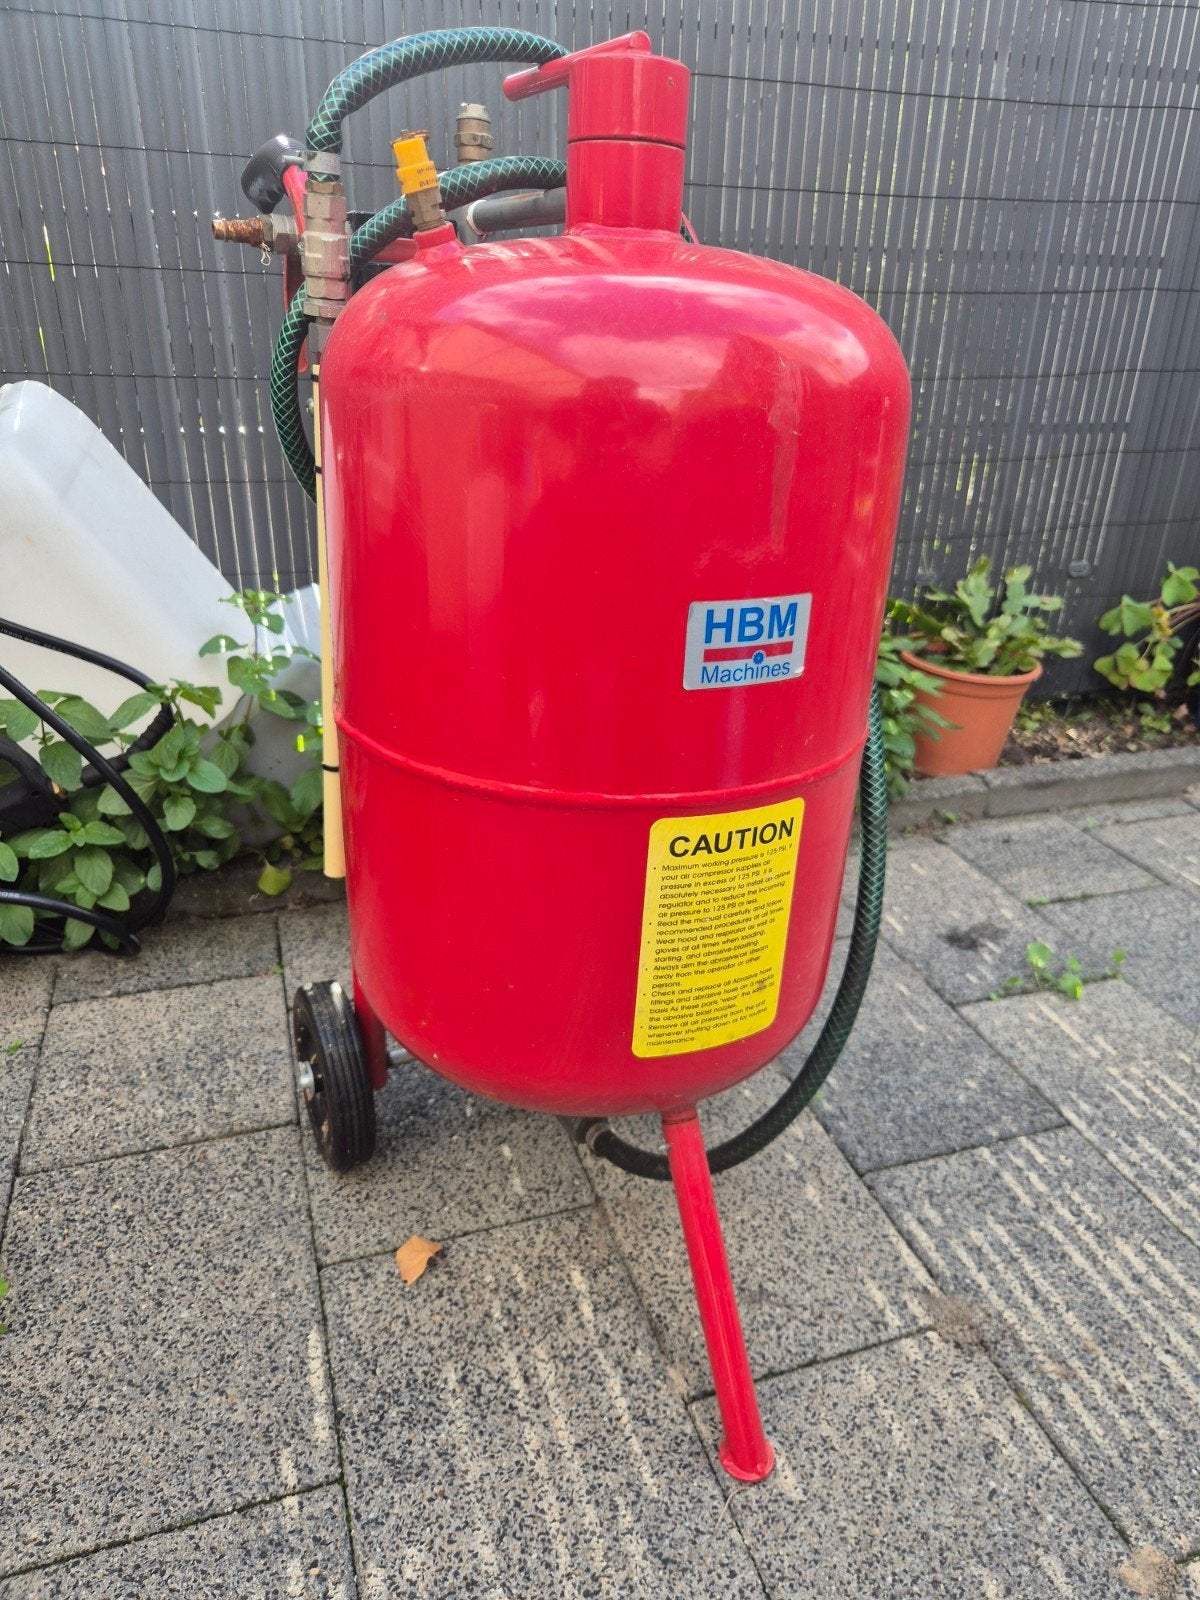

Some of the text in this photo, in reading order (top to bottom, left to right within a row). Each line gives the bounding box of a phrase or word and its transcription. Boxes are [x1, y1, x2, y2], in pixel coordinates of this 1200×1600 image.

[704, 602, 798, 644] HBM
[701, 661, 790, 684] Machines
[669, 817, 795, 857] CAUTION
[702, 859, 730, 868] working
[731, 853, 759, 865] pressure
[767, 847, 777, 856] 125
[661, 874, 679, 882] your
[680, 872, 690, 880] air
[692, 867, 734, 879] compressor
[735, 861, 762, 872] supplies
[660, 882, 692, 891] pressure
[702, 878, 727, 887] excess
[728, 875, 736, 883] of
[738, 872, 750, 880] 125
[658, 901, 694, 909] regulator
[695, 898, 711, 906] and
[721, 892, 746, 901] reduce
[659, 890, 699, 900] absolutely
[700, 885, 737, 896] necessary
[669, 908, 702, 918] pressure
[713, 904, 726, 912] 125
[723, 908, 751, 919] carefully
[752, 903, 766, 912] and
[656, 925, 713, 936] recommended
[713, 917, 752, 930] procedures
[677, 935, 698, 943] hood
[699, 932, 714, 941] and
[715, 926, 747, 938] respirator
[654, 946, 680, 955] gloves
[701, 941, 720, 949] times
[685, 952, 701, 960] and
[706, 962, 737, 974] operator
[651, 990, 676, 998] Check
[677, 987, 693, 995] and
[694, 983, 722, 992] replace
[675, 996, 691, 1004] and
[692, 990, 722, 1001] abrasive
[723, 986, 739, 995] hose
[680, 1003, 700, 1011] these
[701, 1000, 719, 1008] parts
[648, 1023, 679, 1031] Remove
[690, 1018, 700, 1026] air
[700, 1013, 729, 1024] pressure
[662, 1012, 694, 1021] abrasive
[647, 1030, 683, 1039] whenever
